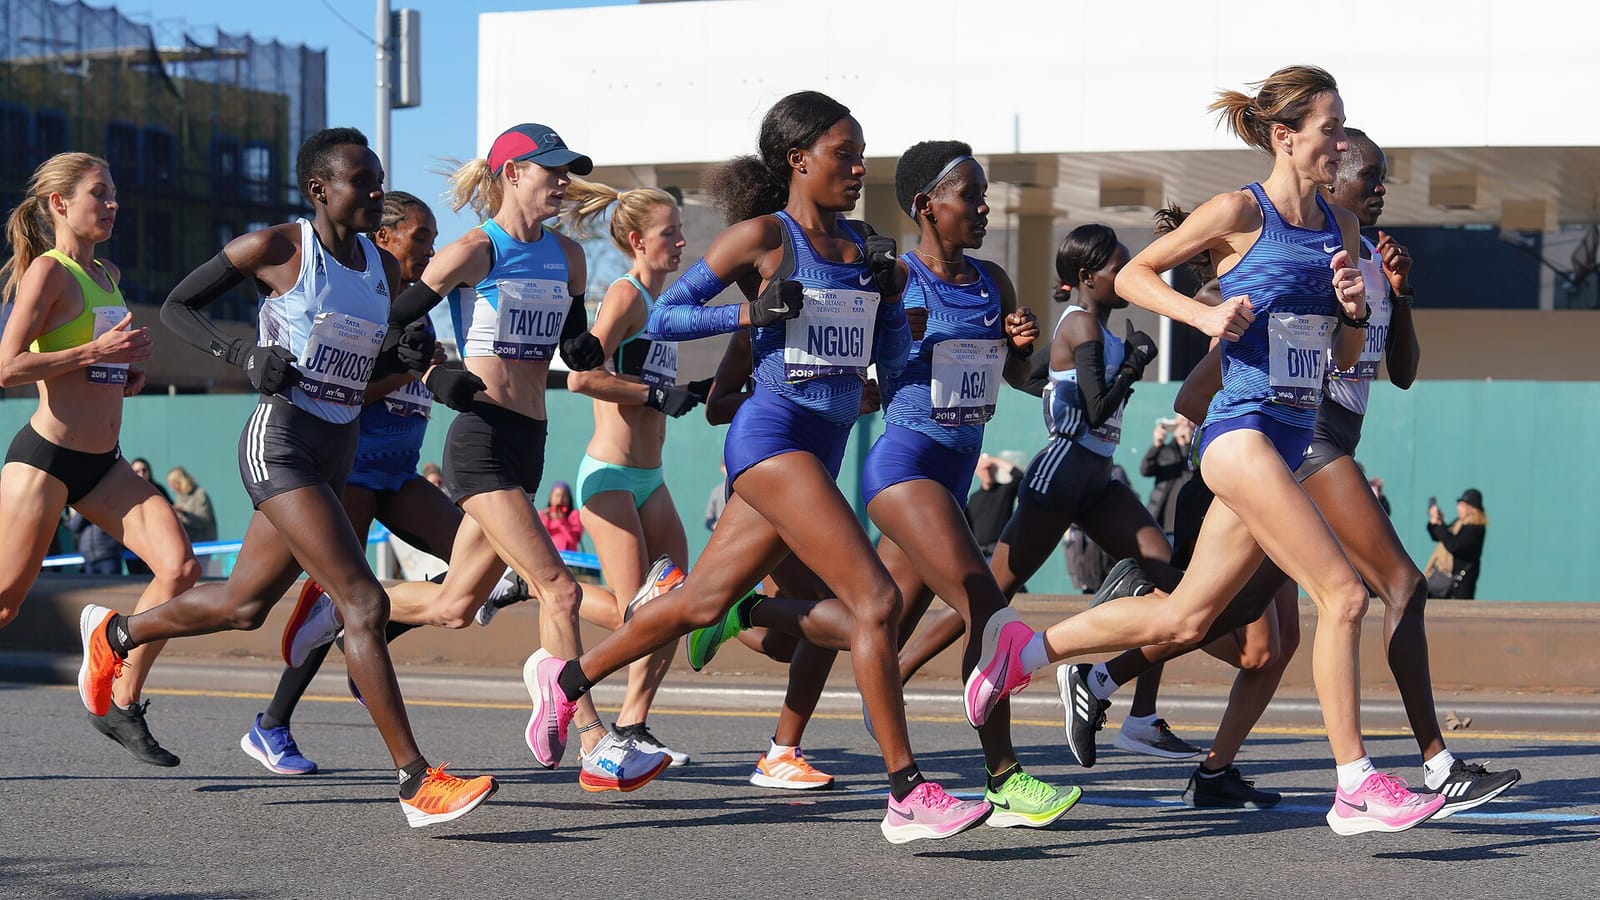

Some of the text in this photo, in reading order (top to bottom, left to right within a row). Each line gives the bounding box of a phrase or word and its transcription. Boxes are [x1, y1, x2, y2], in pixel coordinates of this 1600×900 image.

[345, 319, 360, 328] TATA
[509, 308, 563, 338] TAYLOR
[807, 325, 865, 358] NGUGI
[495, 346, 516, 355] 2019
[90, 370, 107, 379] 2019
[789, 369, 814, 377] 2019
[298, 381, 319, 393] 2019
[960, 371, 986, 399] AGA
[935, 411, 956, 420] 2019
[596, 758, 625, 778] HOKA
